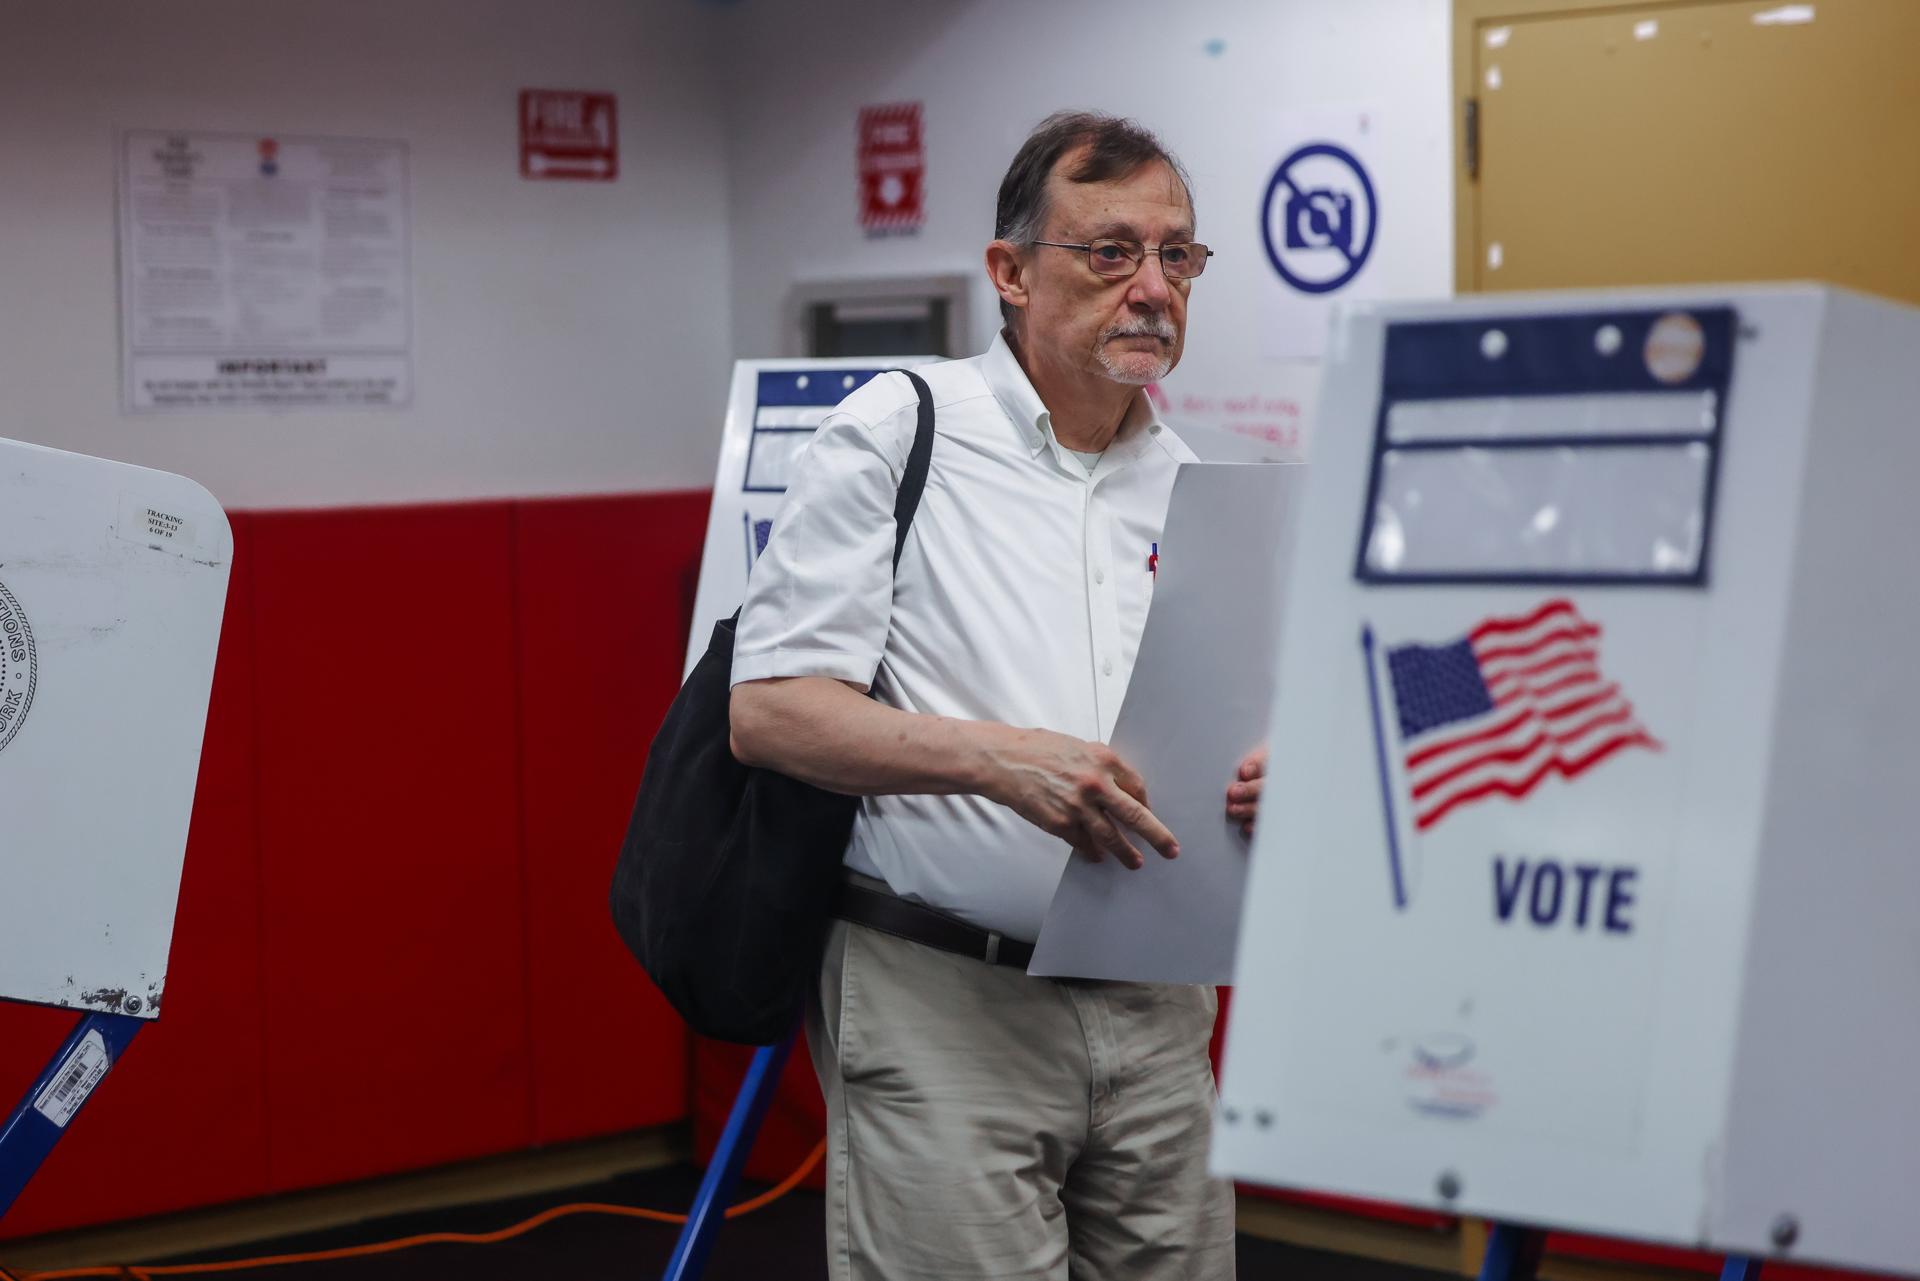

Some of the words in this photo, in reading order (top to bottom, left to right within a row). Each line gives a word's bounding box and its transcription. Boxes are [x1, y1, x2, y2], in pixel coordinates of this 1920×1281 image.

[147, 508, 183, 525] TRACKING
[154, 528, 164, 536] OF
[1493, 856, 1639, 934] VOTE
